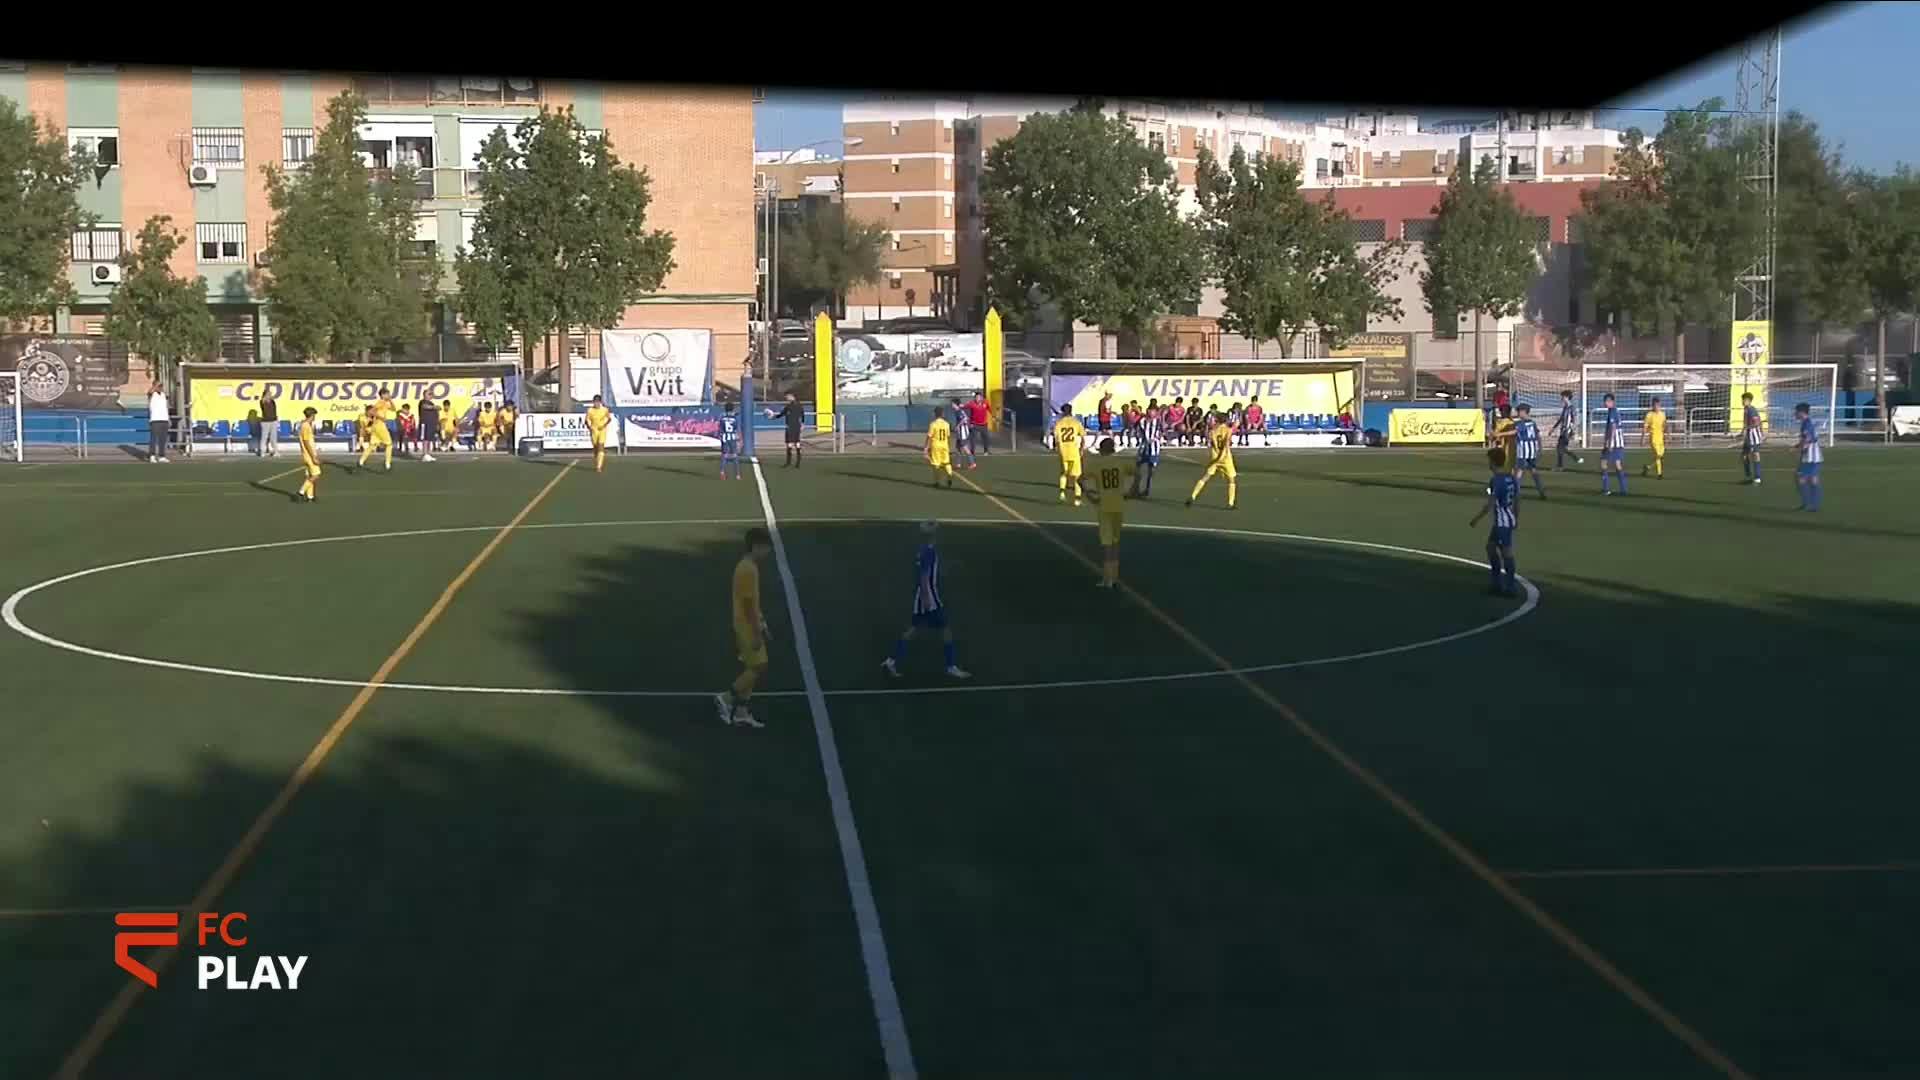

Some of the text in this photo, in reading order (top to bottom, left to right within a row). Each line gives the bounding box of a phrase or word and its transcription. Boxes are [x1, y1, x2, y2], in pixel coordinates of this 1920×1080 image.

[649, 366, 682, 377] grupo
[624, 367, 685, 396] Vivit
[1142, 378, 1283, 397] VISITANTE
[290, 382, 450, 401] MOSQUITO
[1061, 427, 1075, 443] 22
[1102, 468, 1120, 490] 88
